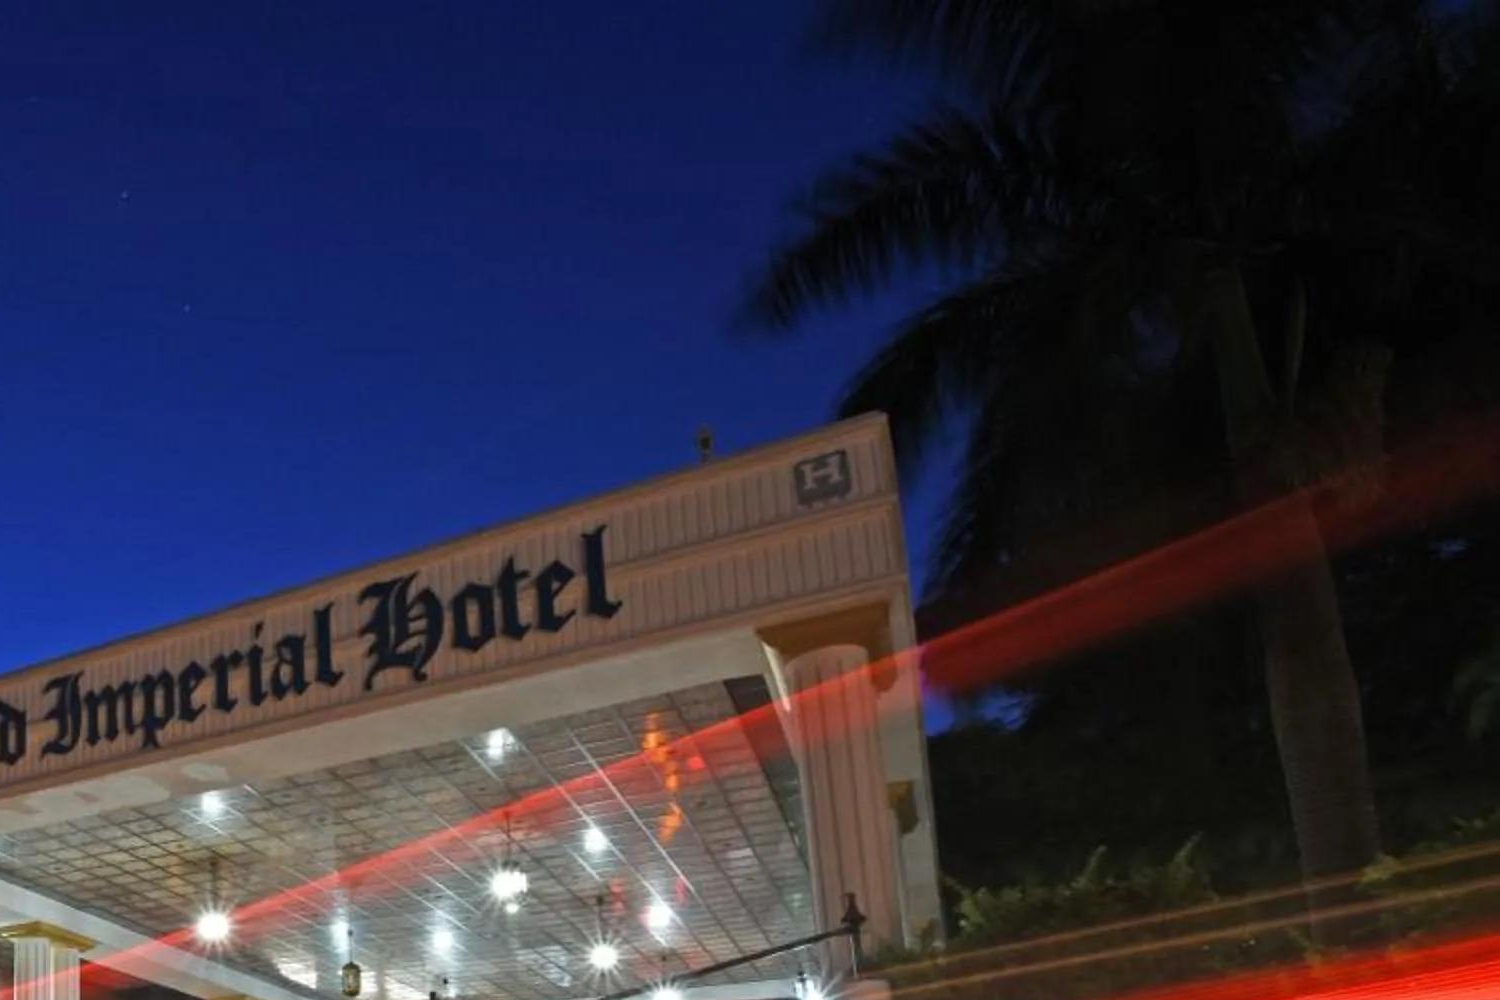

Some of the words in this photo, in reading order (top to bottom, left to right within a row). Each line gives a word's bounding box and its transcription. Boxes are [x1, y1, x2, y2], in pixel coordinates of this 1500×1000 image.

[799, 454, 844, 490] H
[41, 602, 343, 758] Imperial
[358, 525, 622, 690] Hotel
